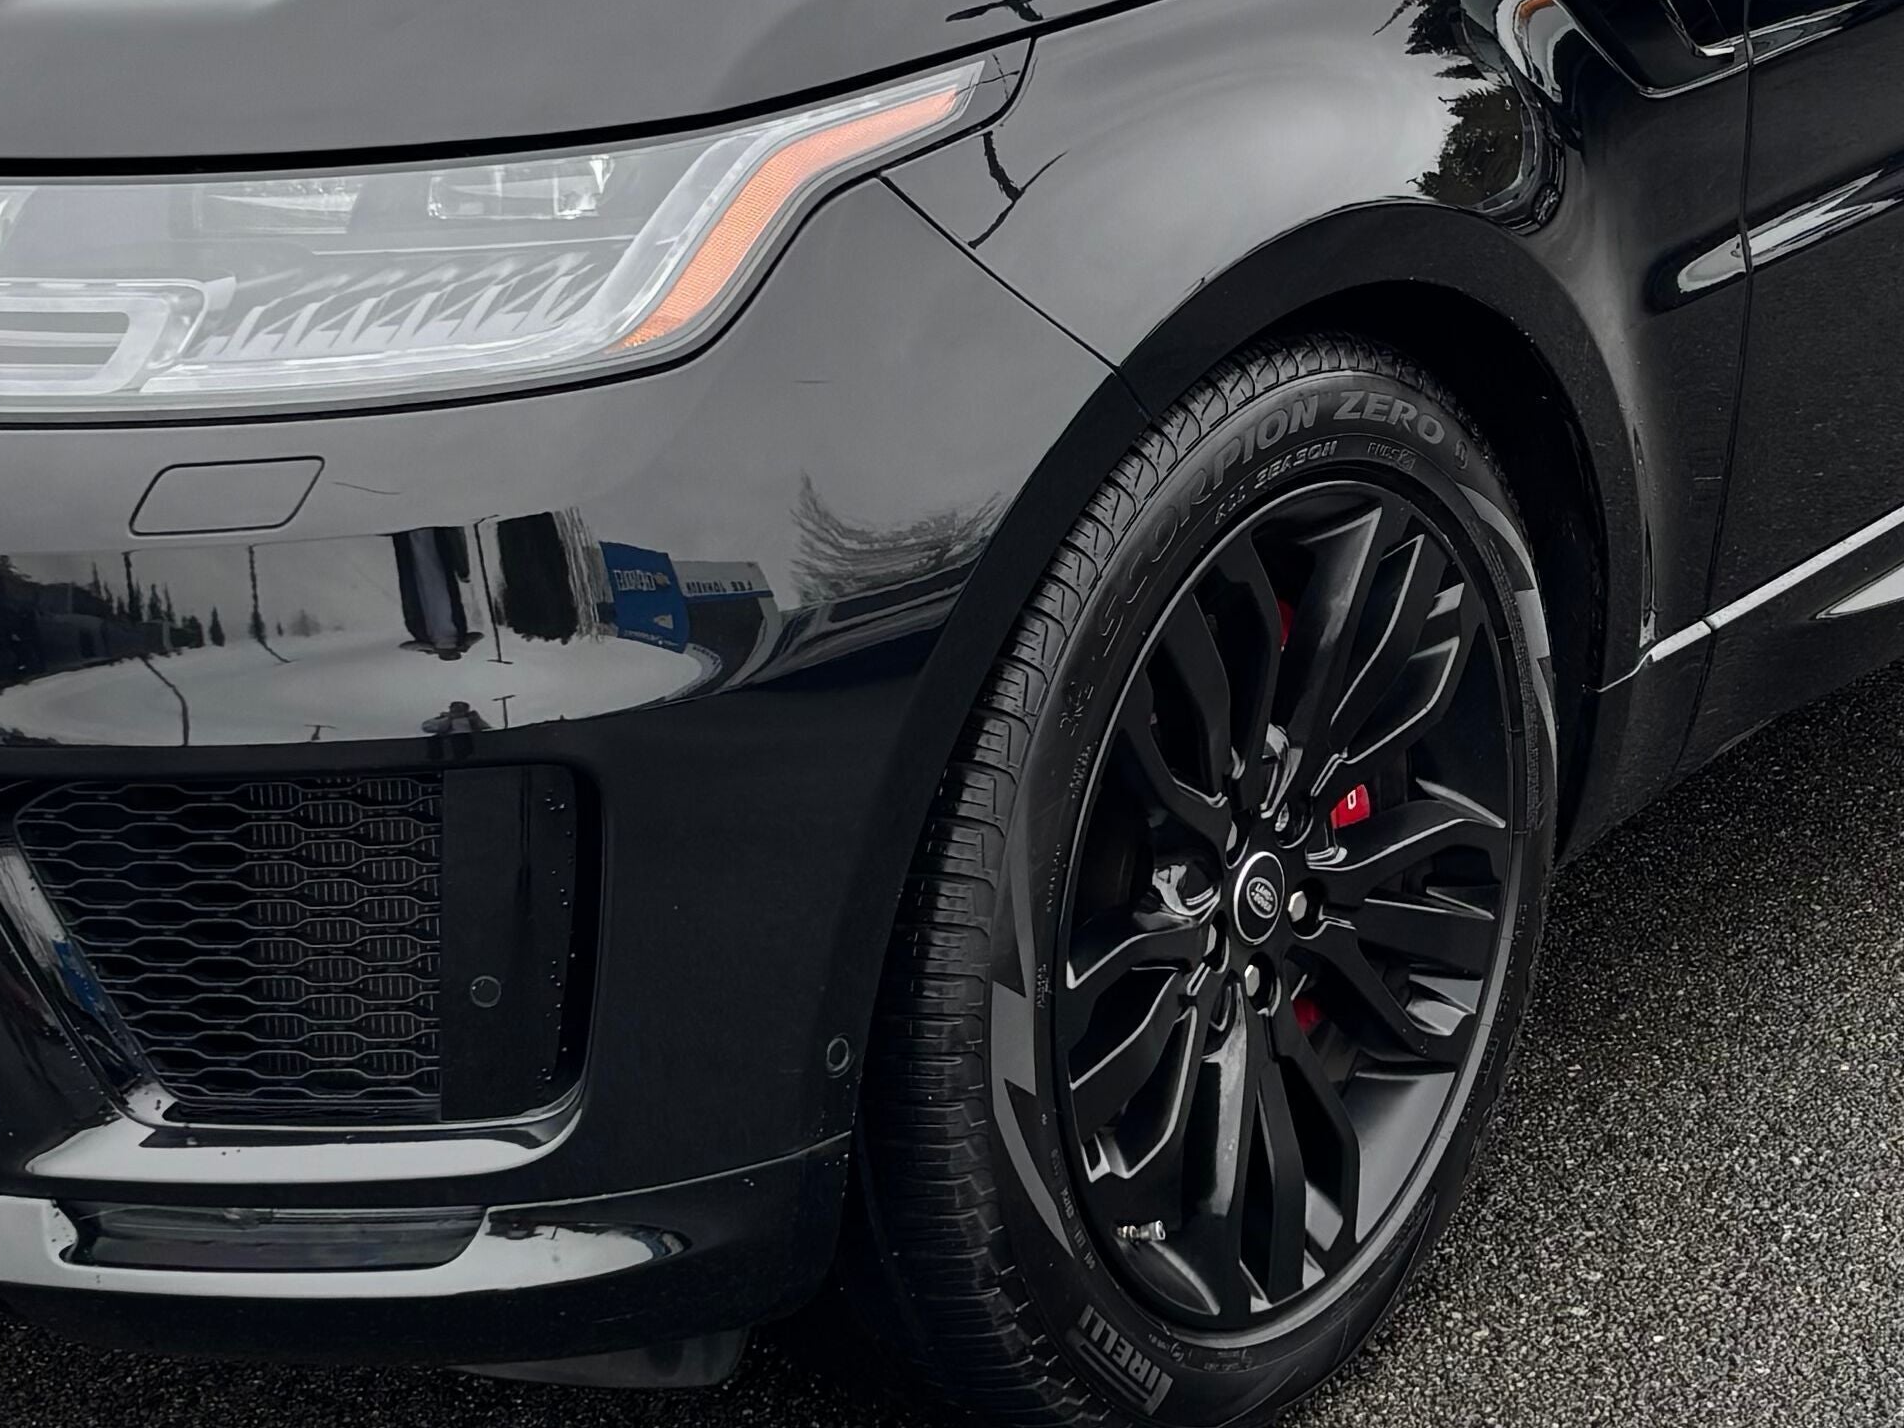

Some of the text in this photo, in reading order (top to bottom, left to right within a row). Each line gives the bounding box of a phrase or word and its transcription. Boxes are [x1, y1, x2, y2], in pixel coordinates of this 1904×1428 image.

[1332, 389, 1447, 447] ZERO
[1253, 439, 1339, 491] SEASON
[1067, 1303, 1174, 1416] PIRELLI
